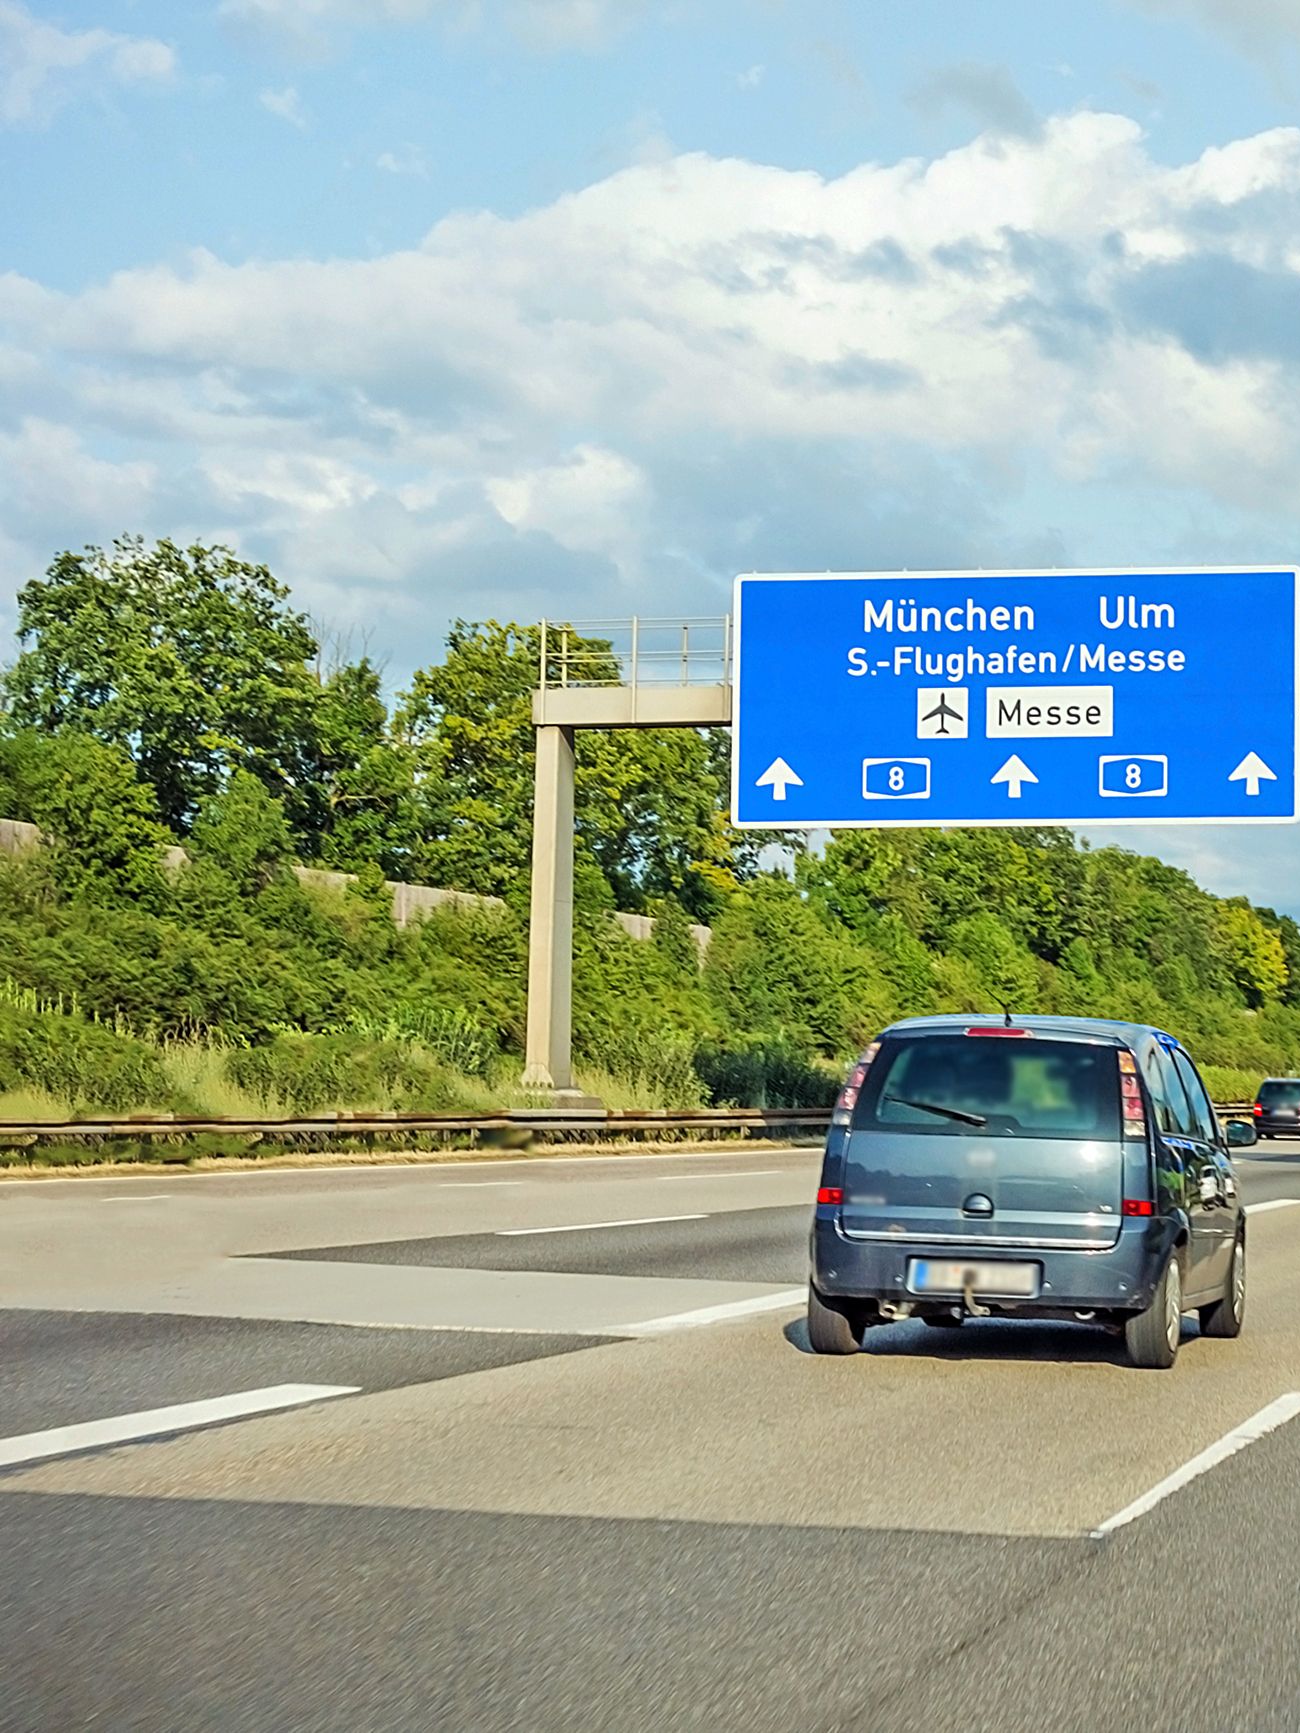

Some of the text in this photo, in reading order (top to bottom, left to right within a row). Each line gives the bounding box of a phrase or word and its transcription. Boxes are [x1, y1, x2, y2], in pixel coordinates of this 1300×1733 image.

[864, 596, 1175, 633] München Ulm
[997, 699, 1102, 726] Messe
[888, 766, 904, 791] 8
[1126, 763, 1142, 788] 8
